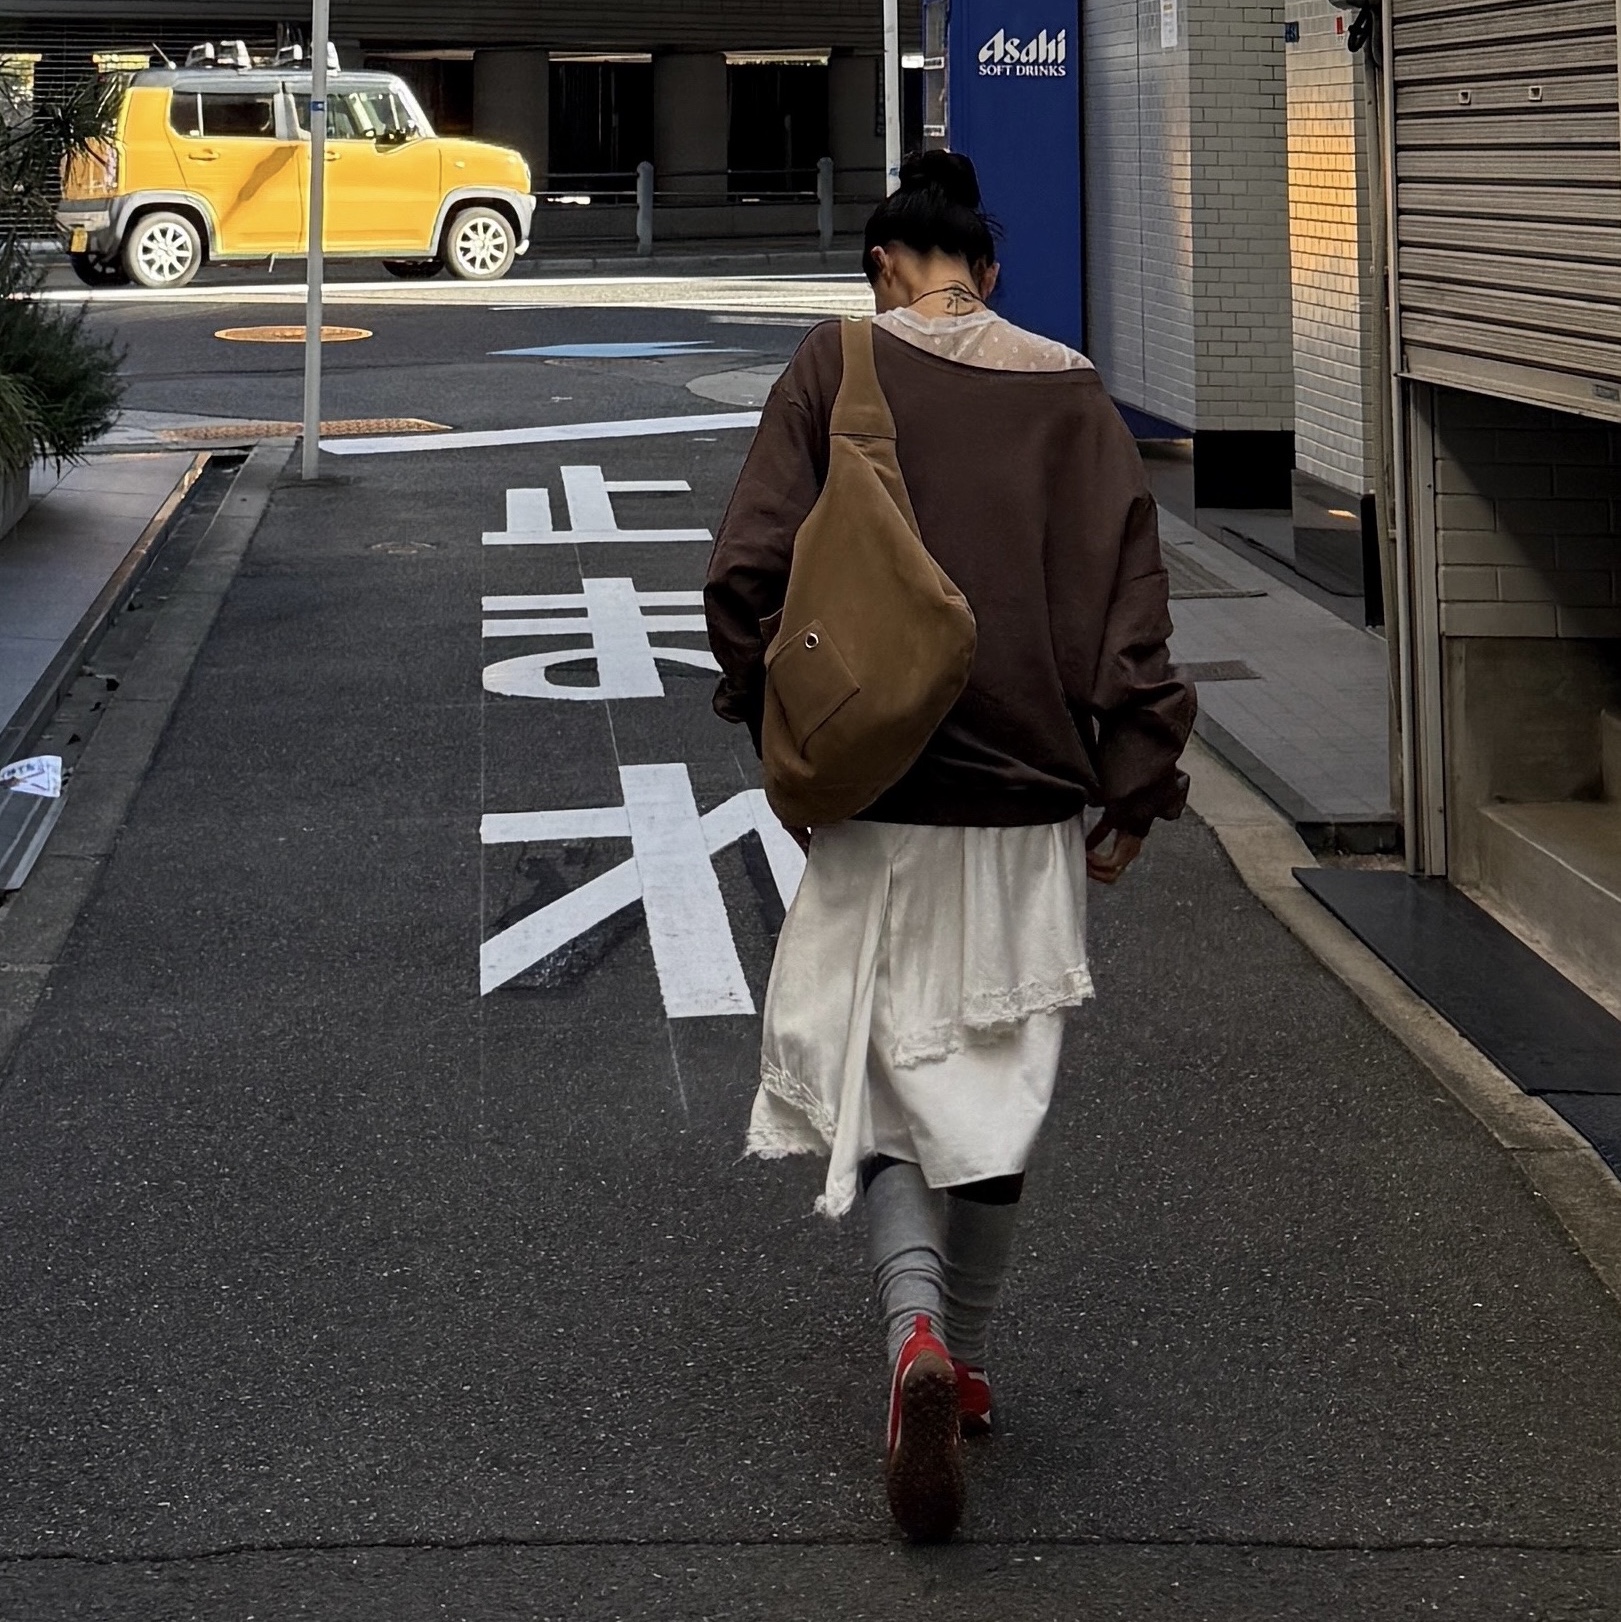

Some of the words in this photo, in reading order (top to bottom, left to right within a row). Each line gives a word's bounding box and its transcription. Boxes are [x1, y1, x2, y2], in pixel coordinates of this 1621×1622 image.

[978, 28, 1065, 64] Asahi
[978, 64, 1013, 76] SOFT
[1016, 65, 1066, 76] DRINKS
[480, 465, 808, 1020] 止まれ
